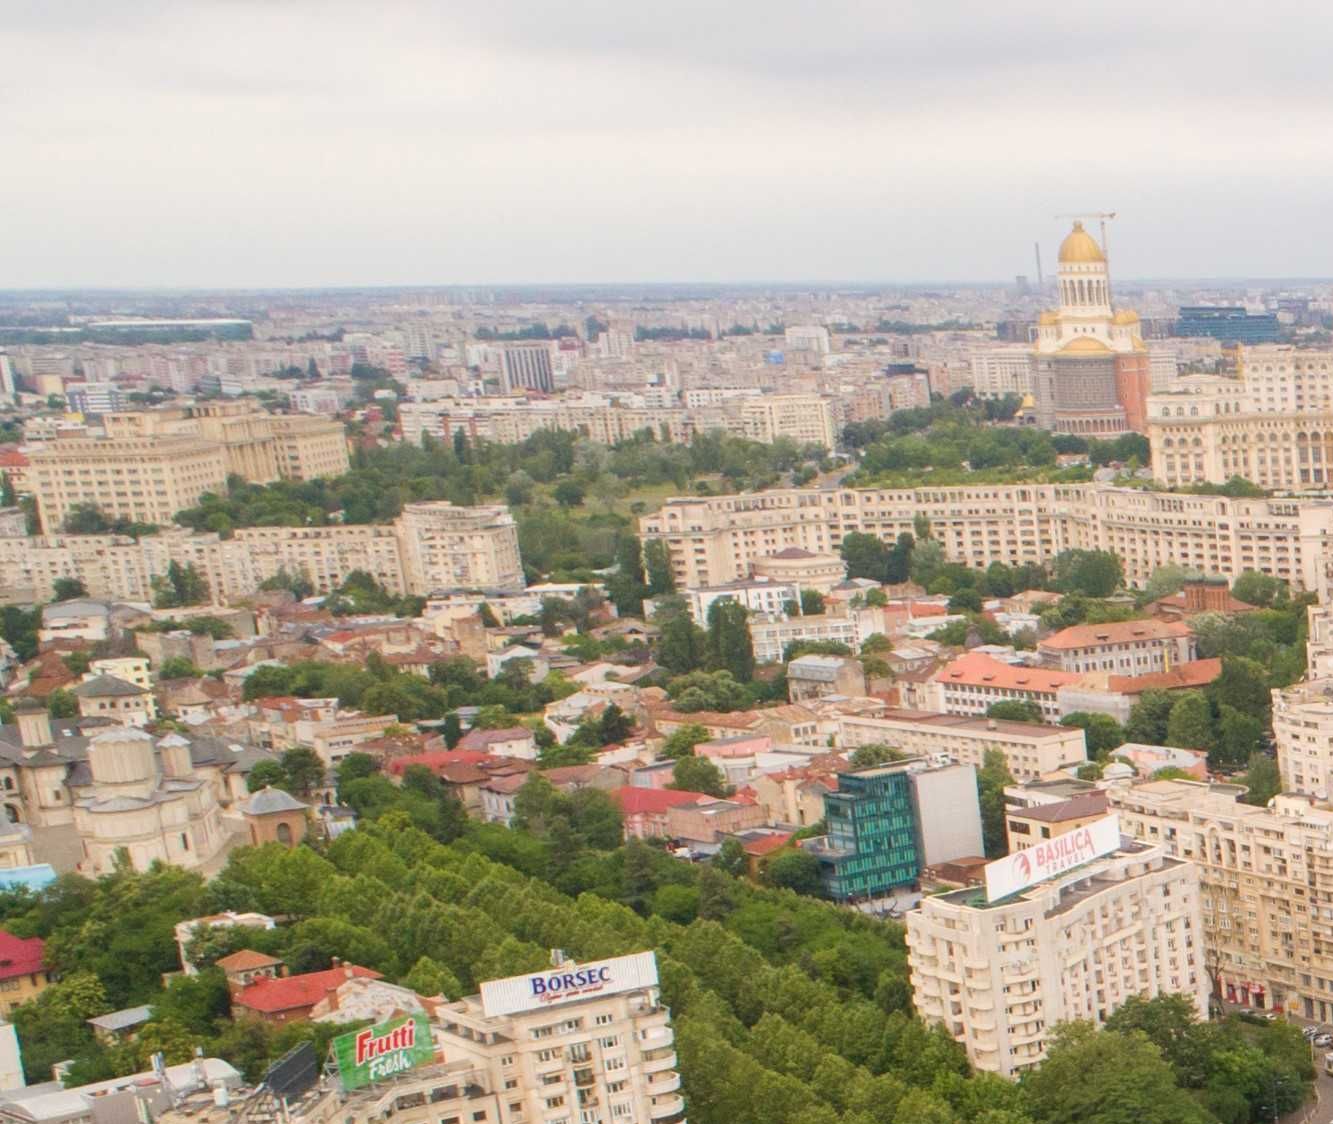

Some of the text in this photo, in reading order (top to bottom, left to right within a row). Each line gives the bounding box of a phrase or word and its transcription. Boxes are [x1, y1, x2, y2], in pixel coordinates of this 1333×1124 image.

[1035, 828, 1096, 867] BASILICA
[1046, 853, 1086, 873] TRAVEL
[531, 966, 611, 995] BORSEC
[356, 1019, 415, 1066] Frutti
[369, 1049, 411, 1080] Fresh
